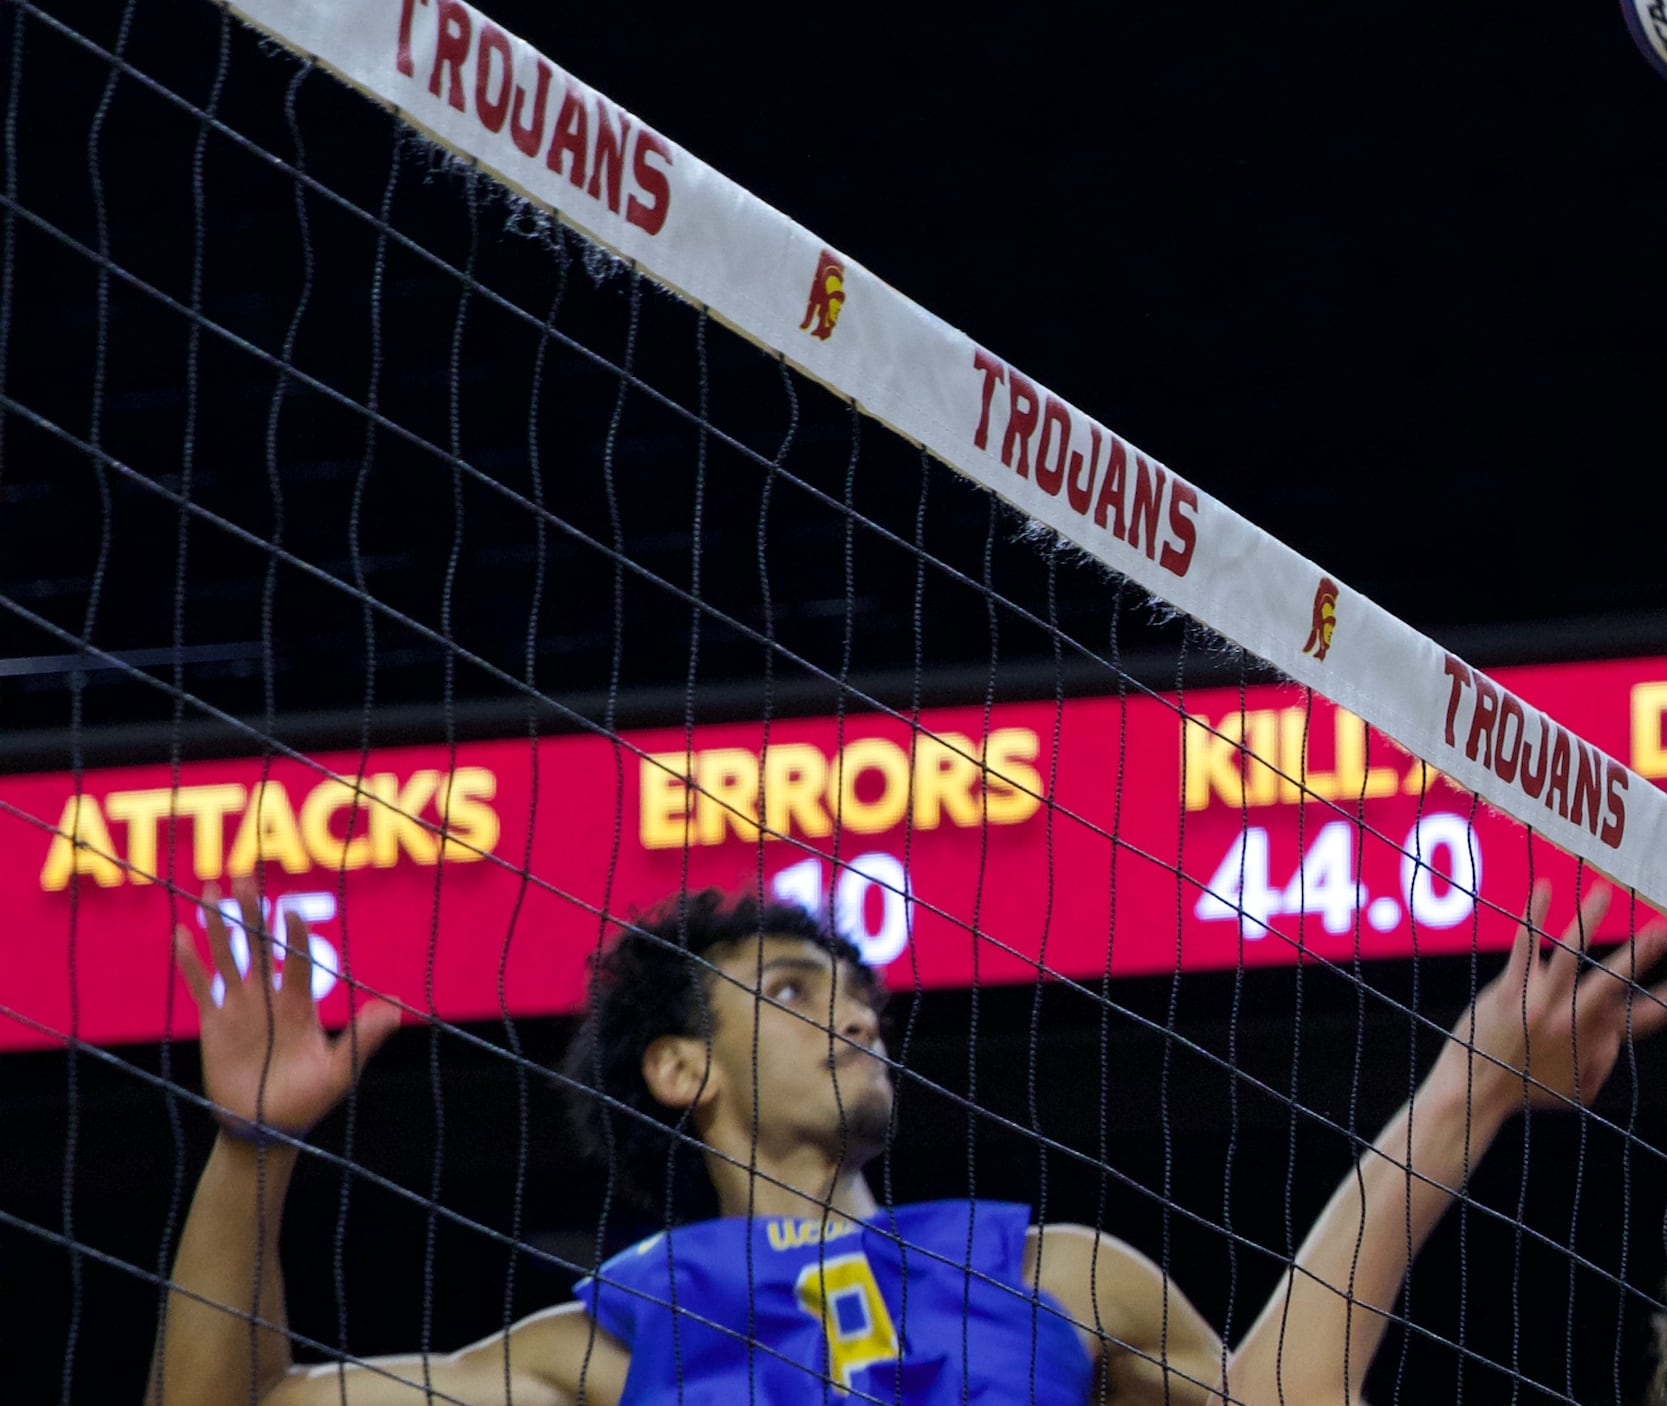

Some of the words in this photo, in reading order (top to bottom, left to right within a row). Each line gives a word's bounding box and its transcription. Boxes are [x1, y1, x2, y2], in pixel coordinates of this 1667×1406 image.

[396, 0, 673, 236] TROJANS
[974, 347, 1198, 578] TROJANS
[640, 727, 1043, 850] ERRORS
[1186, 705, 1440, 811] KILL
[1445, 654, 1629, 850] TROJANS
[41, 766, 499, 891] ATTACKS
[1194, 811, 1482, 940] 44.0
